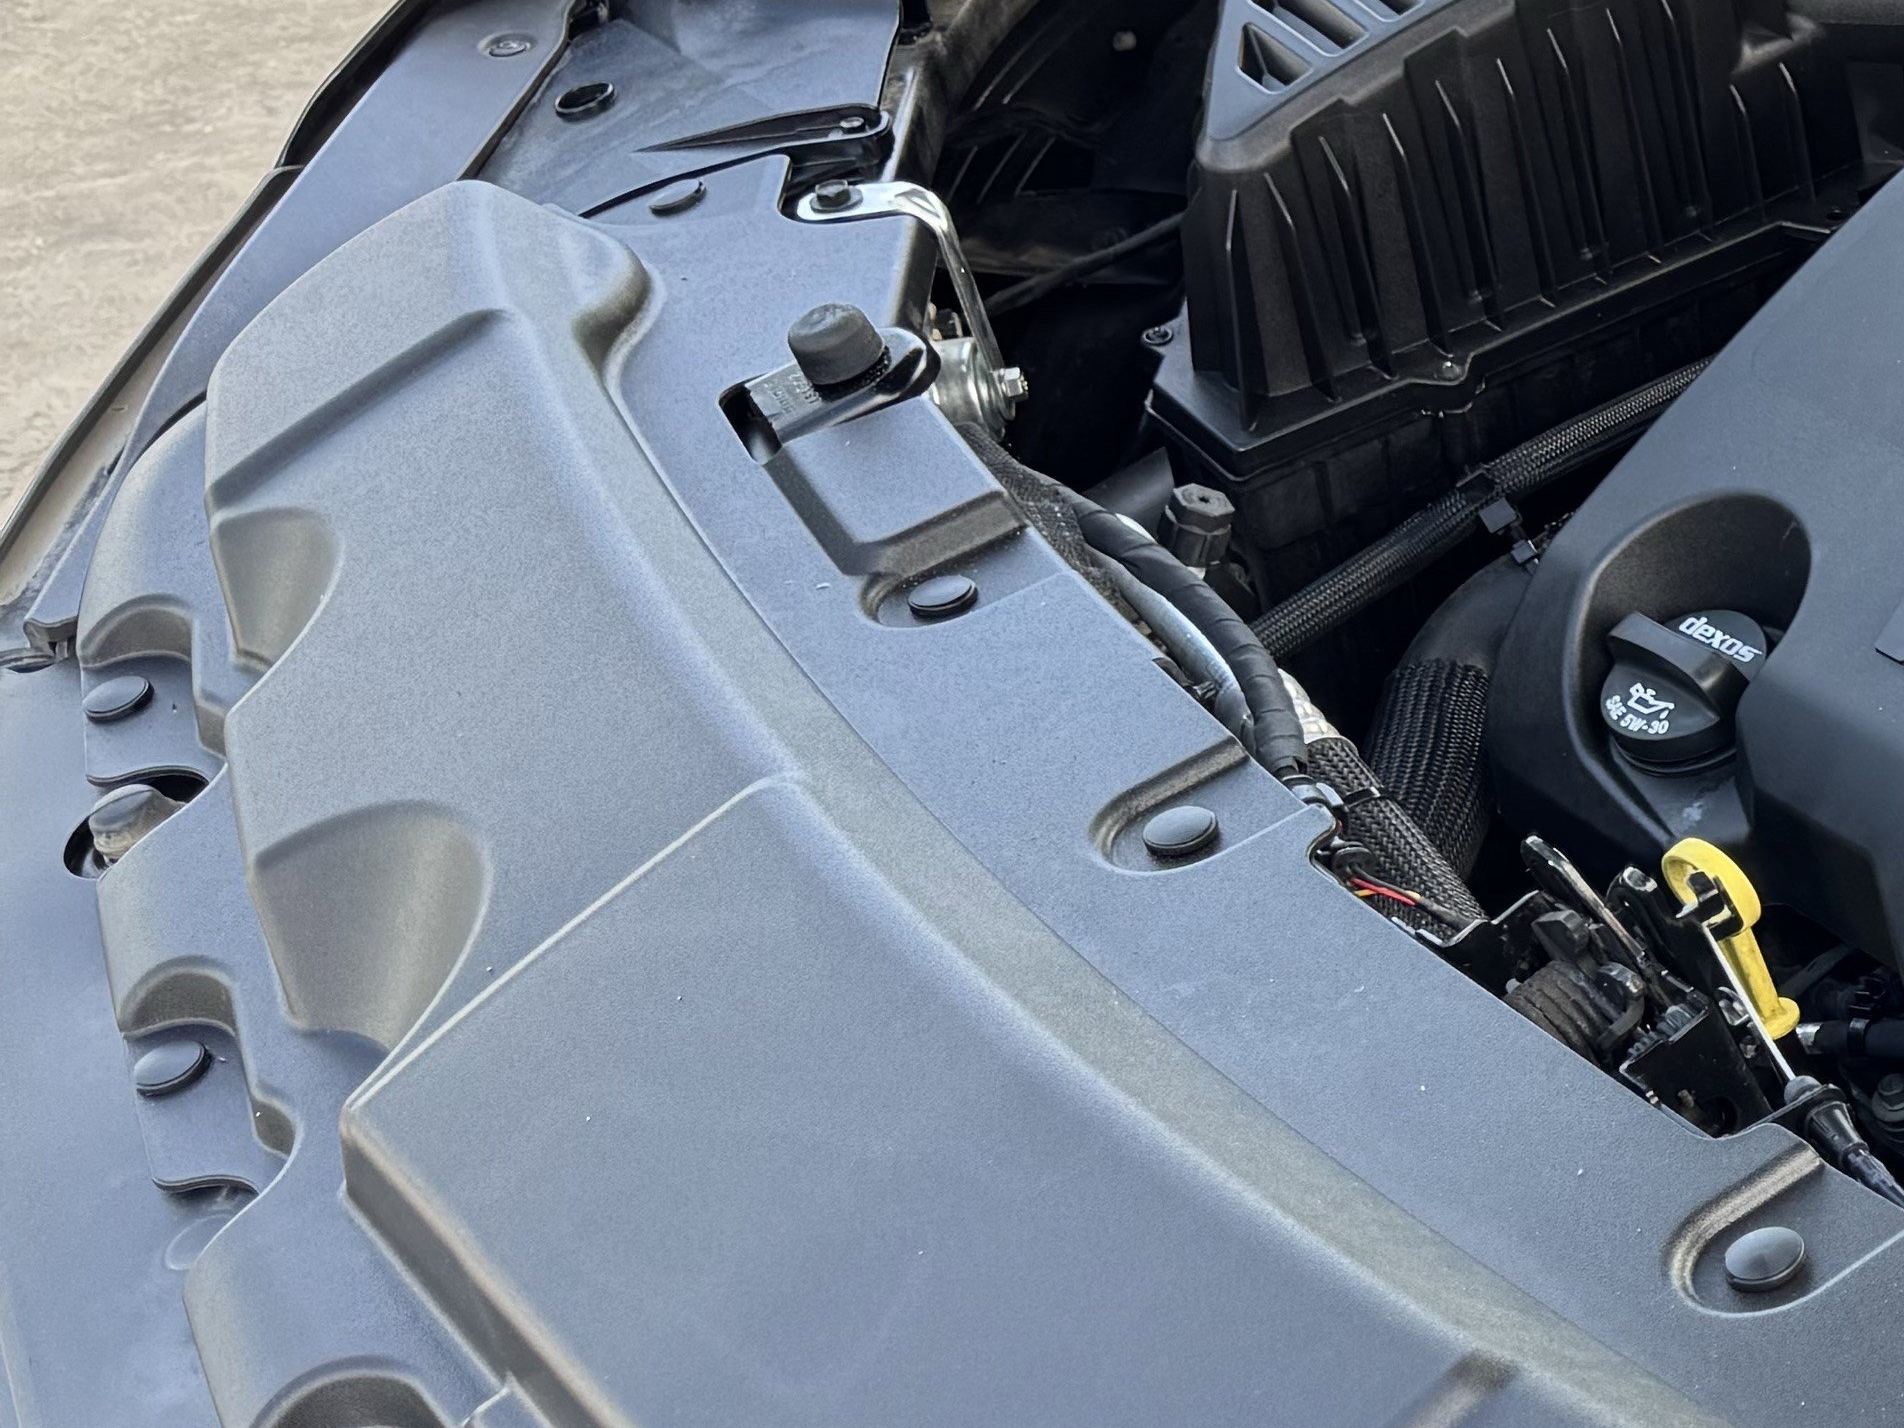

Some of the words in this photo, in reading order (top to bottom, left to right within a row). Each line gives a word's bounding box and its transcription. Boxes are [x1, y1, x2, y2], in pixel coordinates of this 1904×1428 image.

[1677, 615, 1763, 663] dexos
[1605, 694, 1627, 721] SAE
[1619, 714, 1670, 735] 5W-30
